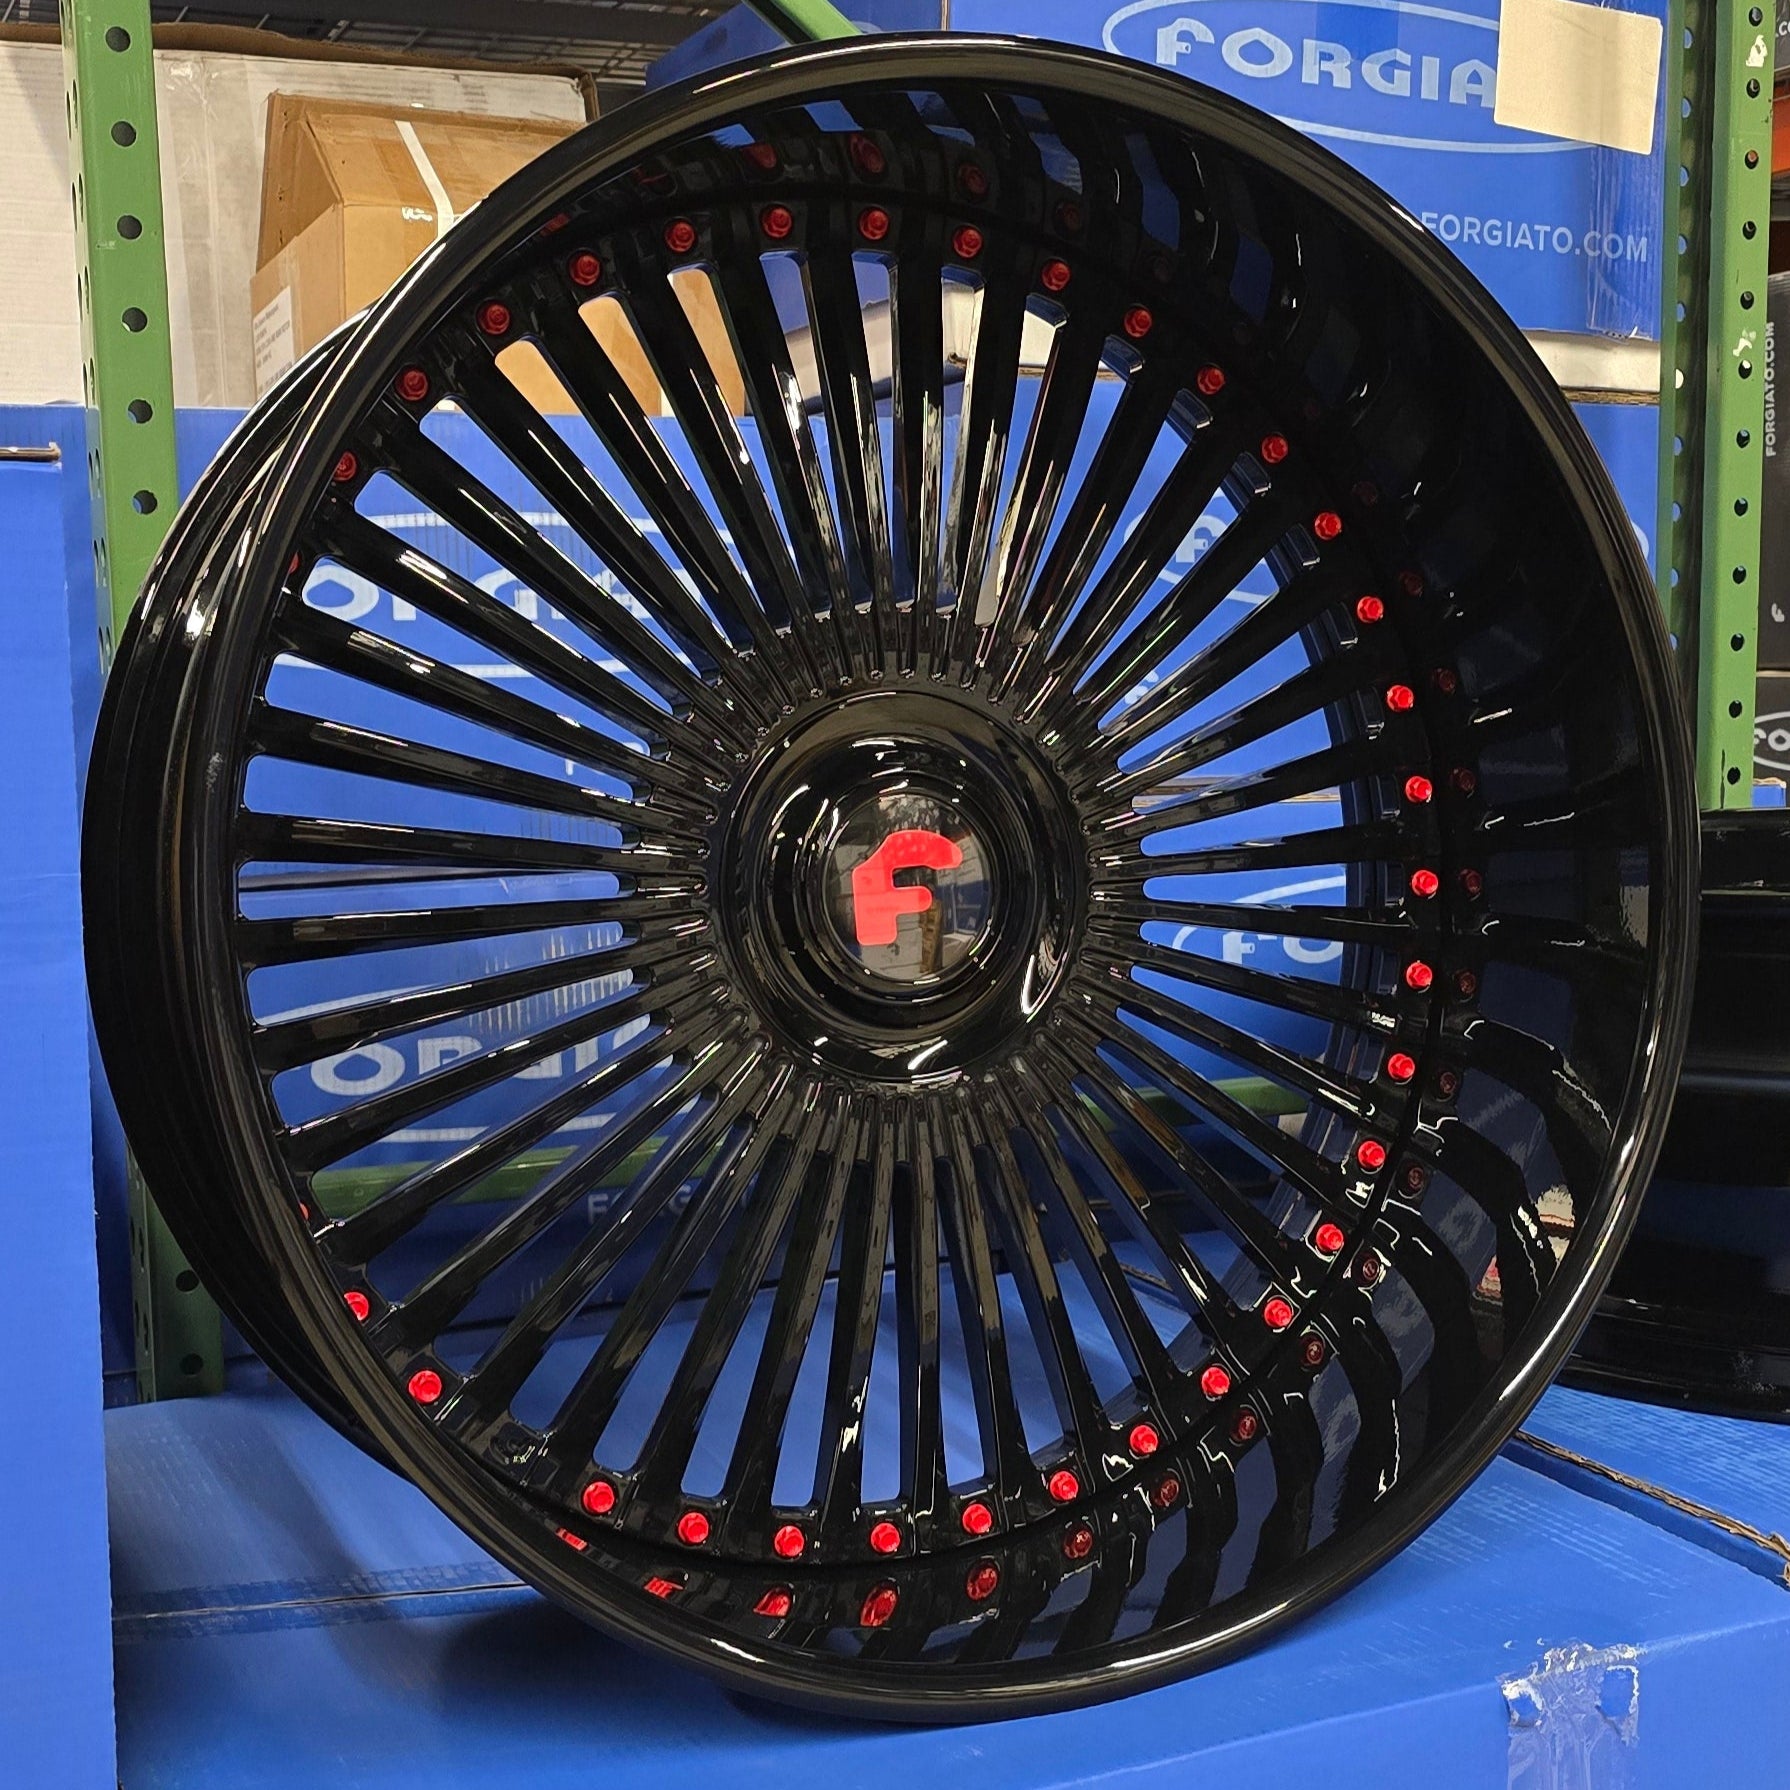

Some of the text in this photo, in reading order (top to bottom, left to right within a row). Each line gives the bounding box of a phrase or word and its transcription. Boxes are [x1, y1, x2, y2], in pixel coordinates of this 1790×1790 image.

[1156, 17, 1497, 108] FORGIA
[1421, 211, 1648, 263] FORGIATO.COM
[1764, 321, 1777, 457] FORGIATO.COM
